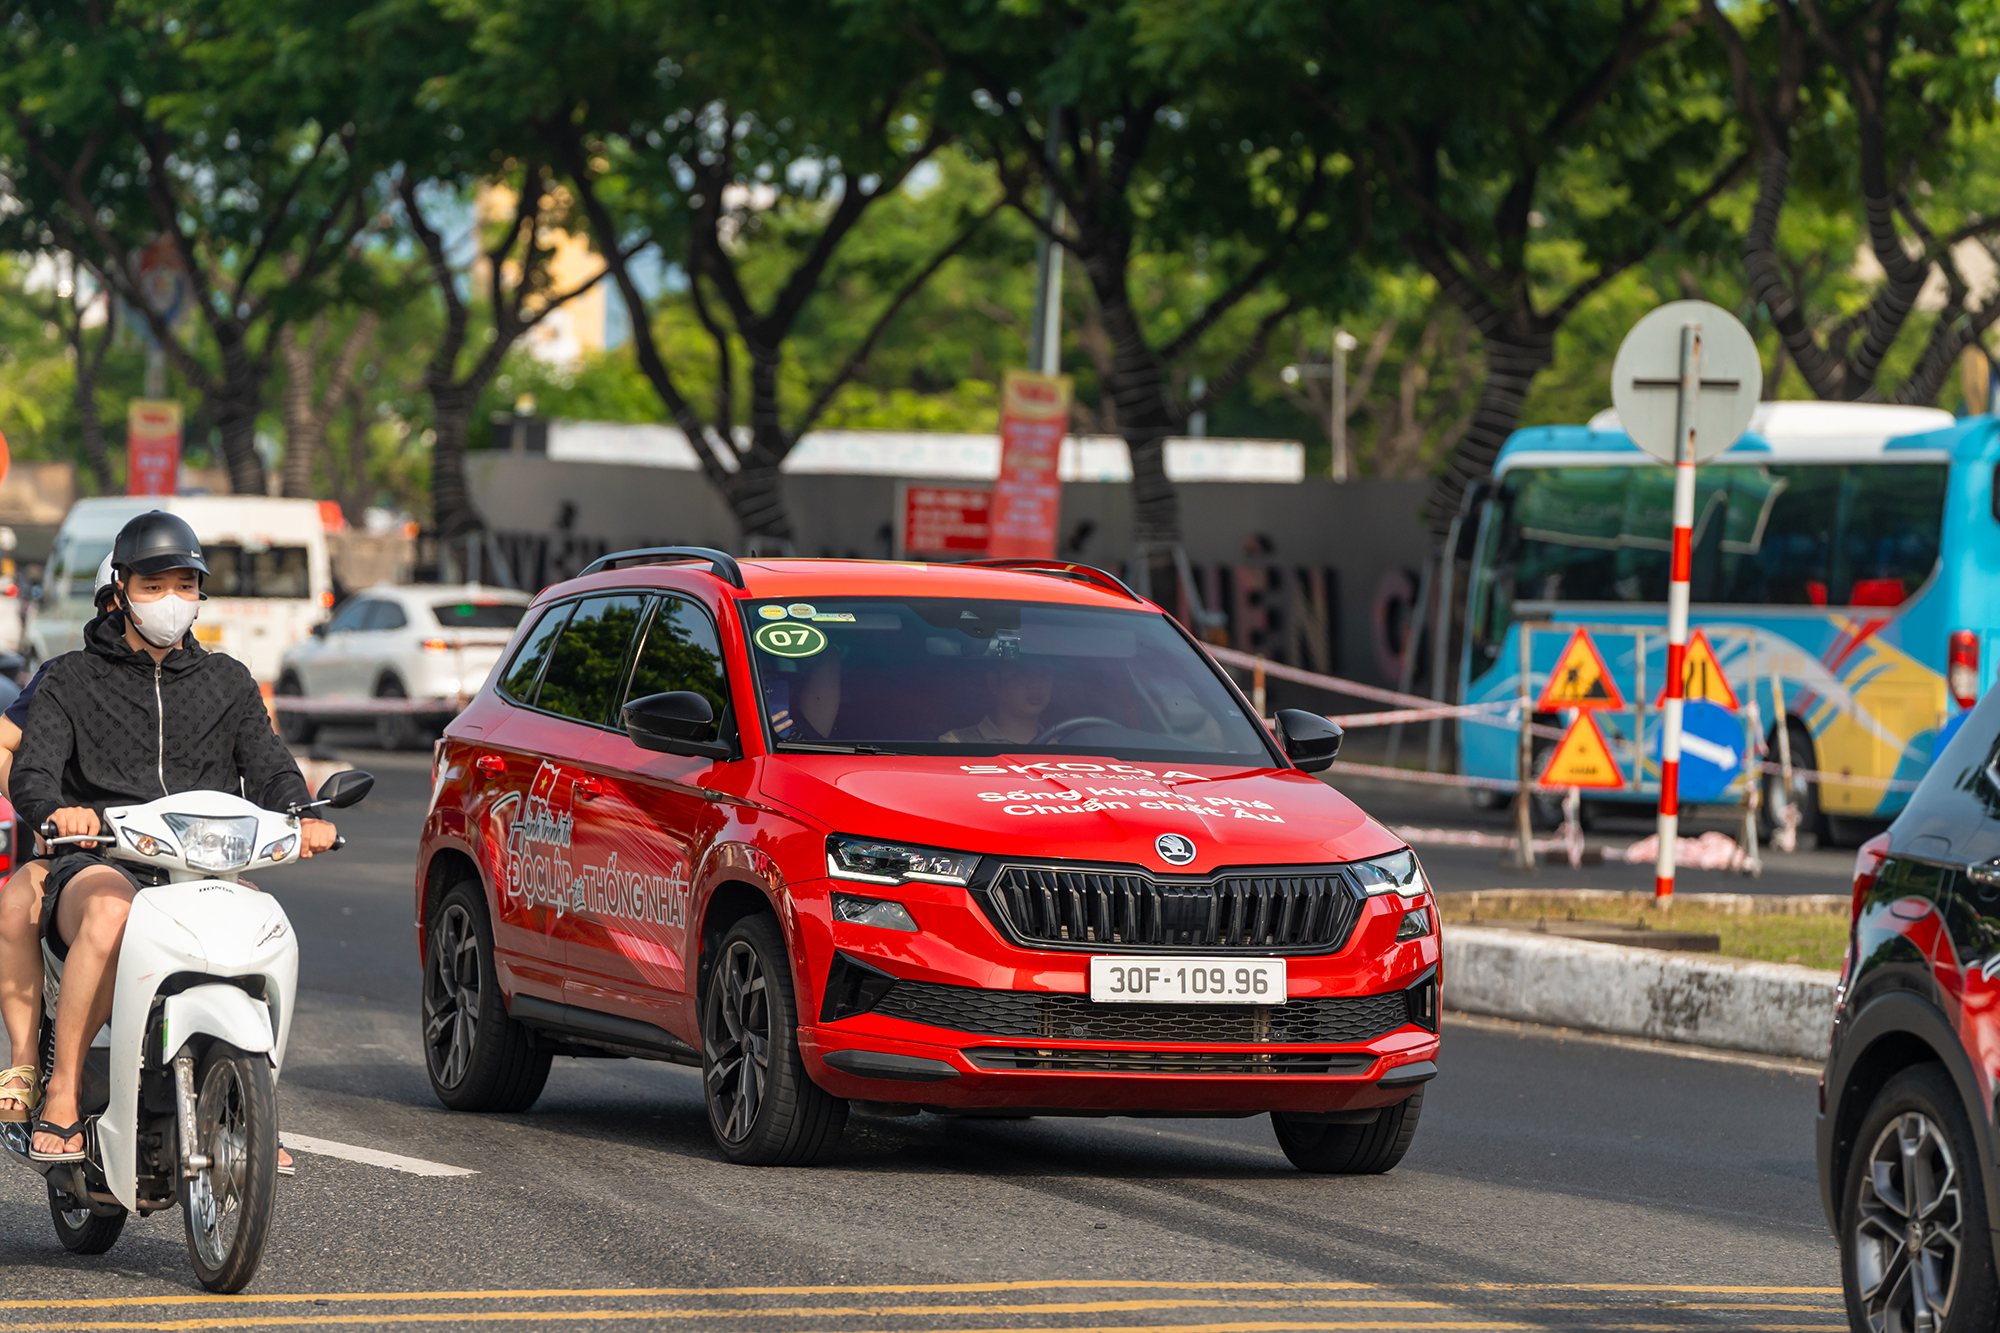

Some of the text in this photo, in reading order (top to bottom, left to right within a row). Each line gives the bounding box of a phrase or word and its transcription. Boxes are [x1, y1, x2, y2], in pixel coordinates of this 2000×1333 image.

[768, 630, 810, 646] 07
[977, 786, 1275, 810] Sống khám phá
[1003, 798, 1286, 824] Chuẩn chất Âu
[199, 885, 235, 895] HONDA
[507, 841, 547, 910] ĐỘC
[545, 847, 573, 919] LẬP
[583, 851, 645, 921] THỐNG
[644, 861, 689, 930] NHẤT
[1109, 966, 1268, 994] 30F-109.96
